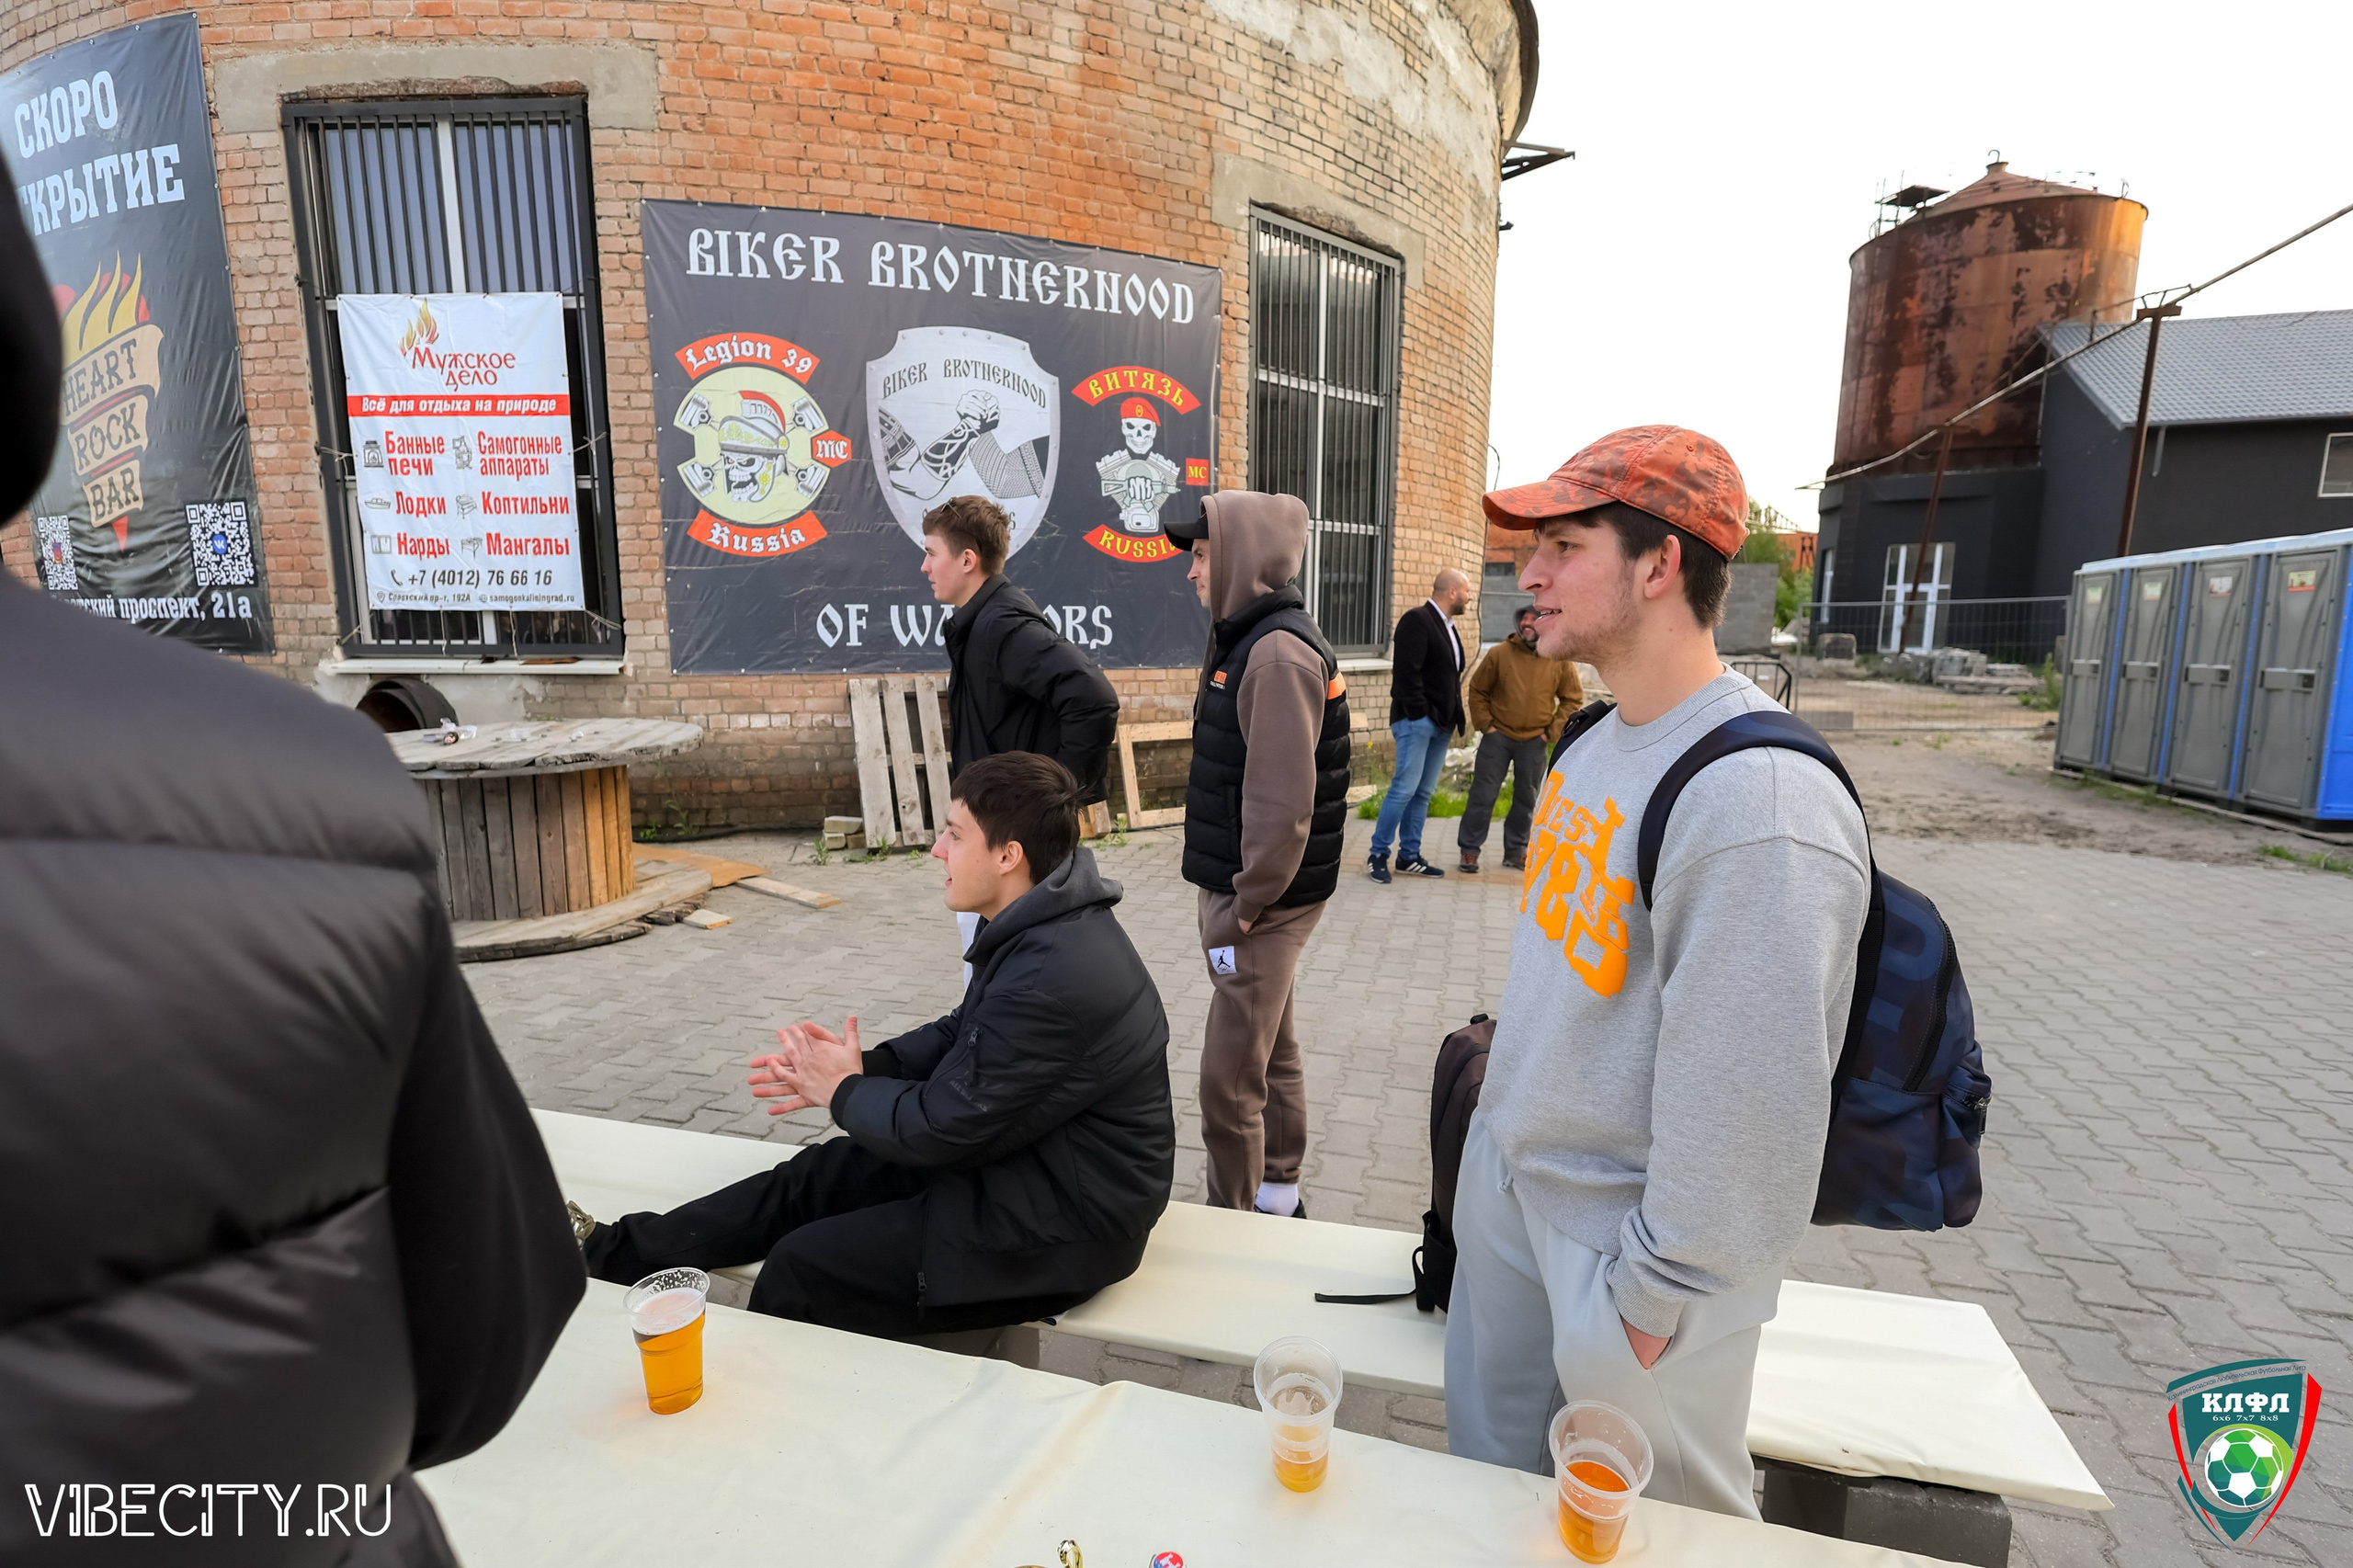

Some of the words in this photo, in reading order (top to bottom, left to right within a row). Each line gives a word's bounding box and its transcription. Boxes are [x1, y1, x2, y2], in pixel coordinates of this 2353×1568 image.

[14, 70, 119, 159] СКОРО
[17, 143, 186, 236] КРЫТИЕ
[686, 227, 844, 284] BIKER
[411, 347, 517, 375] Мужское
[686, 335, 772, 372] Legion
[781, 348, 813, 374] 39
[63, 338, 138, 418] HEART
[445, 369, 498, 392] дело
[882, 361, 928, 401] BIKER
[1088, 369, 1185, 407] ВИТЯЗЬ
[361, 397, 387, 413] Всё
[389, 399, 415, 414] для
[418, 399, 472, 414] отдыха
[474, 399, 492, 413] на
[496, 398, 557, 414] природе
[74, 402, 141, 472] ROCK
[384, 430, 445, 456] Банные
[477, 430, 563, 456] Самогонные
[815, 439, 848, 460] MC
[388, 457, 434, 476] печи
[480, 457, 550, 481] аппараты
[90, 467, 140, 522] BAR
[395, 491, 447, 518] Лодки
[482, 491, 570, 515] Коптильни
[396, 532, 450, 561] Нарды
[485, 532, 570, 556] Мангалы
[706, 522, 806, 554] Russia
[408, 570, 426, 586] +7
[431, 570, 480, 589] (4012)
[487, 570, 505, 585] 76
[510, 570, 529, 585] 66
[534, 569, 552, 585] 16
[119, 597, 207, 625] проспект,
[816, 602, 870, 649] OF
